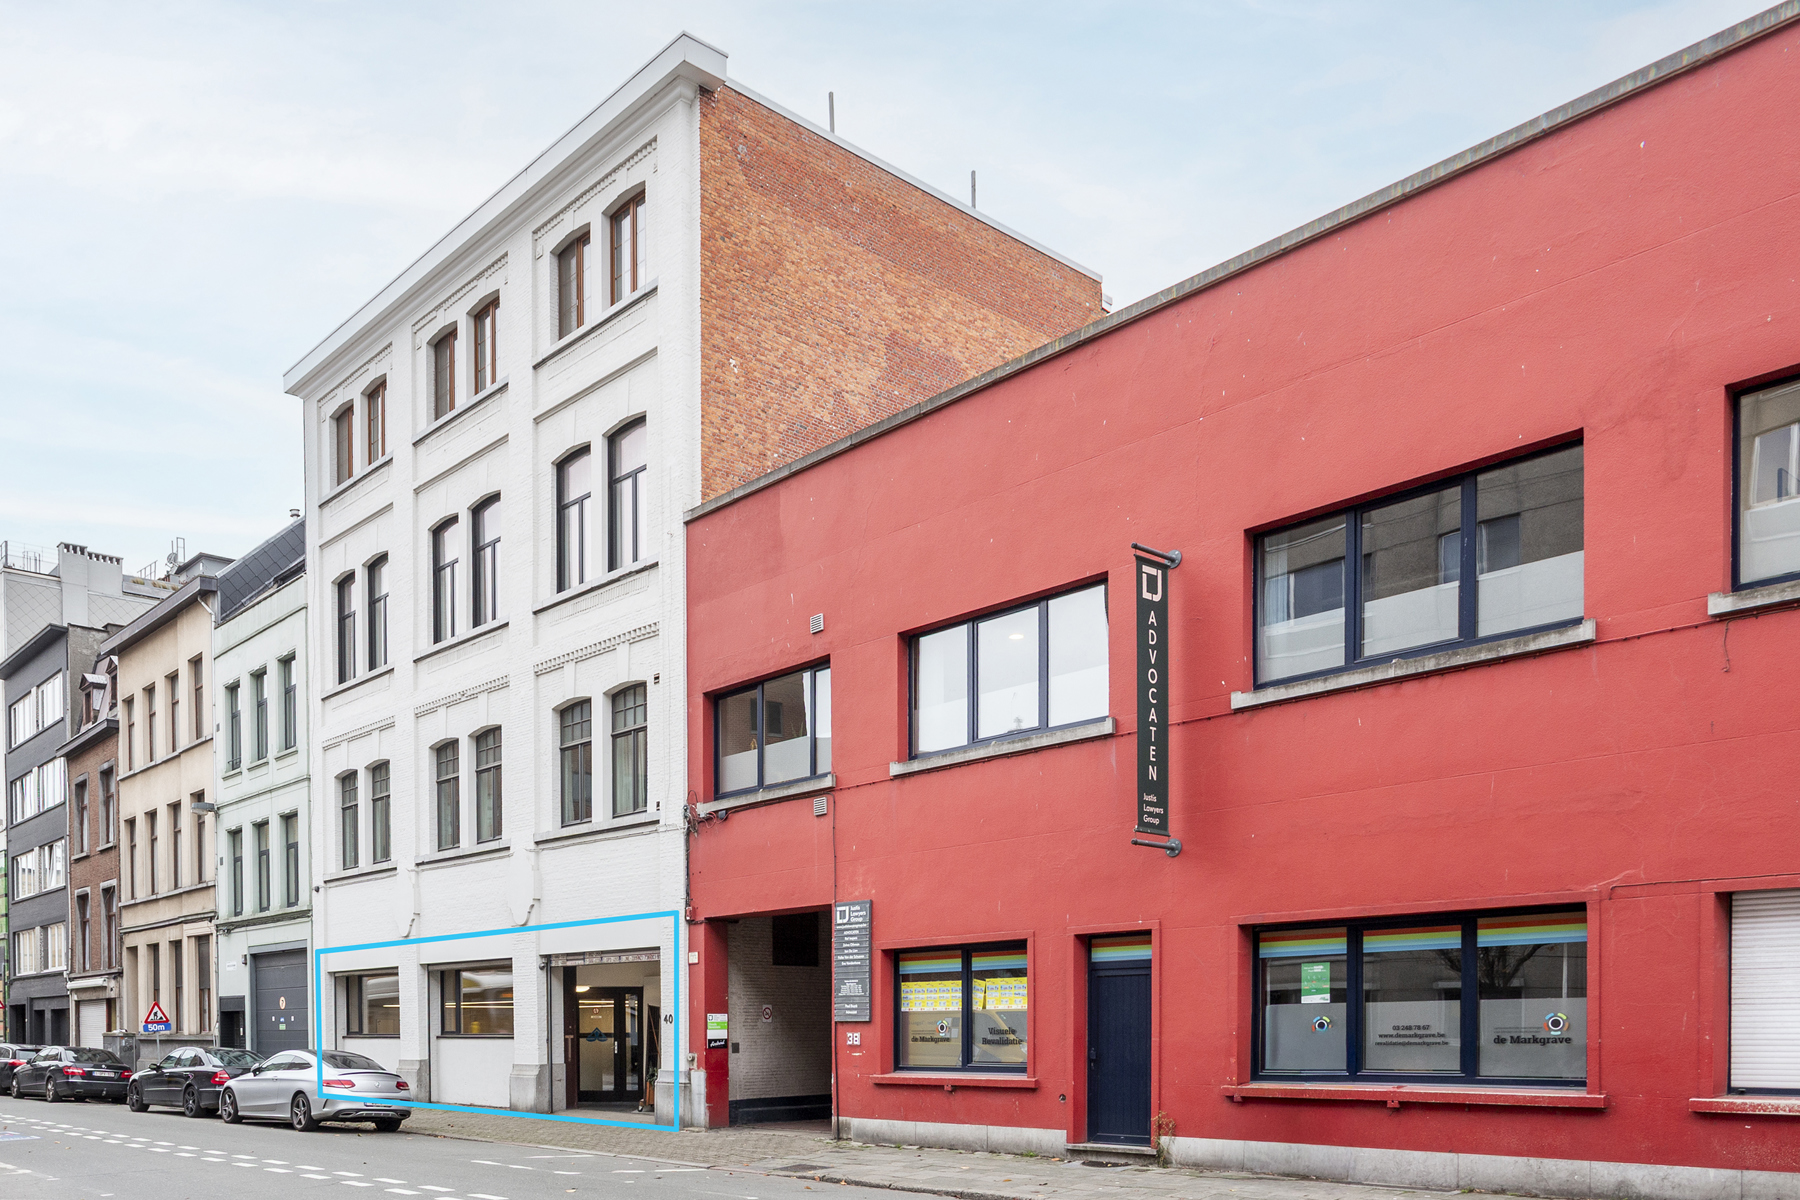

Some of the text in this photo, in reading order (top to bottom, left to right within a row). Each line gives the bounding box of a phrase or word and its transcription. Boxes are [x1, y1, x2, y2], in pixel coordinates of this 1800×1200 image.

[1147, 610, 1158, 781] ADVOCATEN
[1143, 792, 1157, 802] Justis
[1143, 803, 1164, 814] Lawyers
[1143, 814, 1160, 825] Group
[664, 1014, 673, 1024] 40
[148, 1023, 165, 1031] 50m
[988, 1027, 1017, 1035] Visuele
[847, 1033, 860, 1045] 38
[919, 1036, 950, 1044] Markgrave
[982, 1037, 1022, 1045] Revalidatie
[1493, 1035, 1571, 1046] de Markgrave
